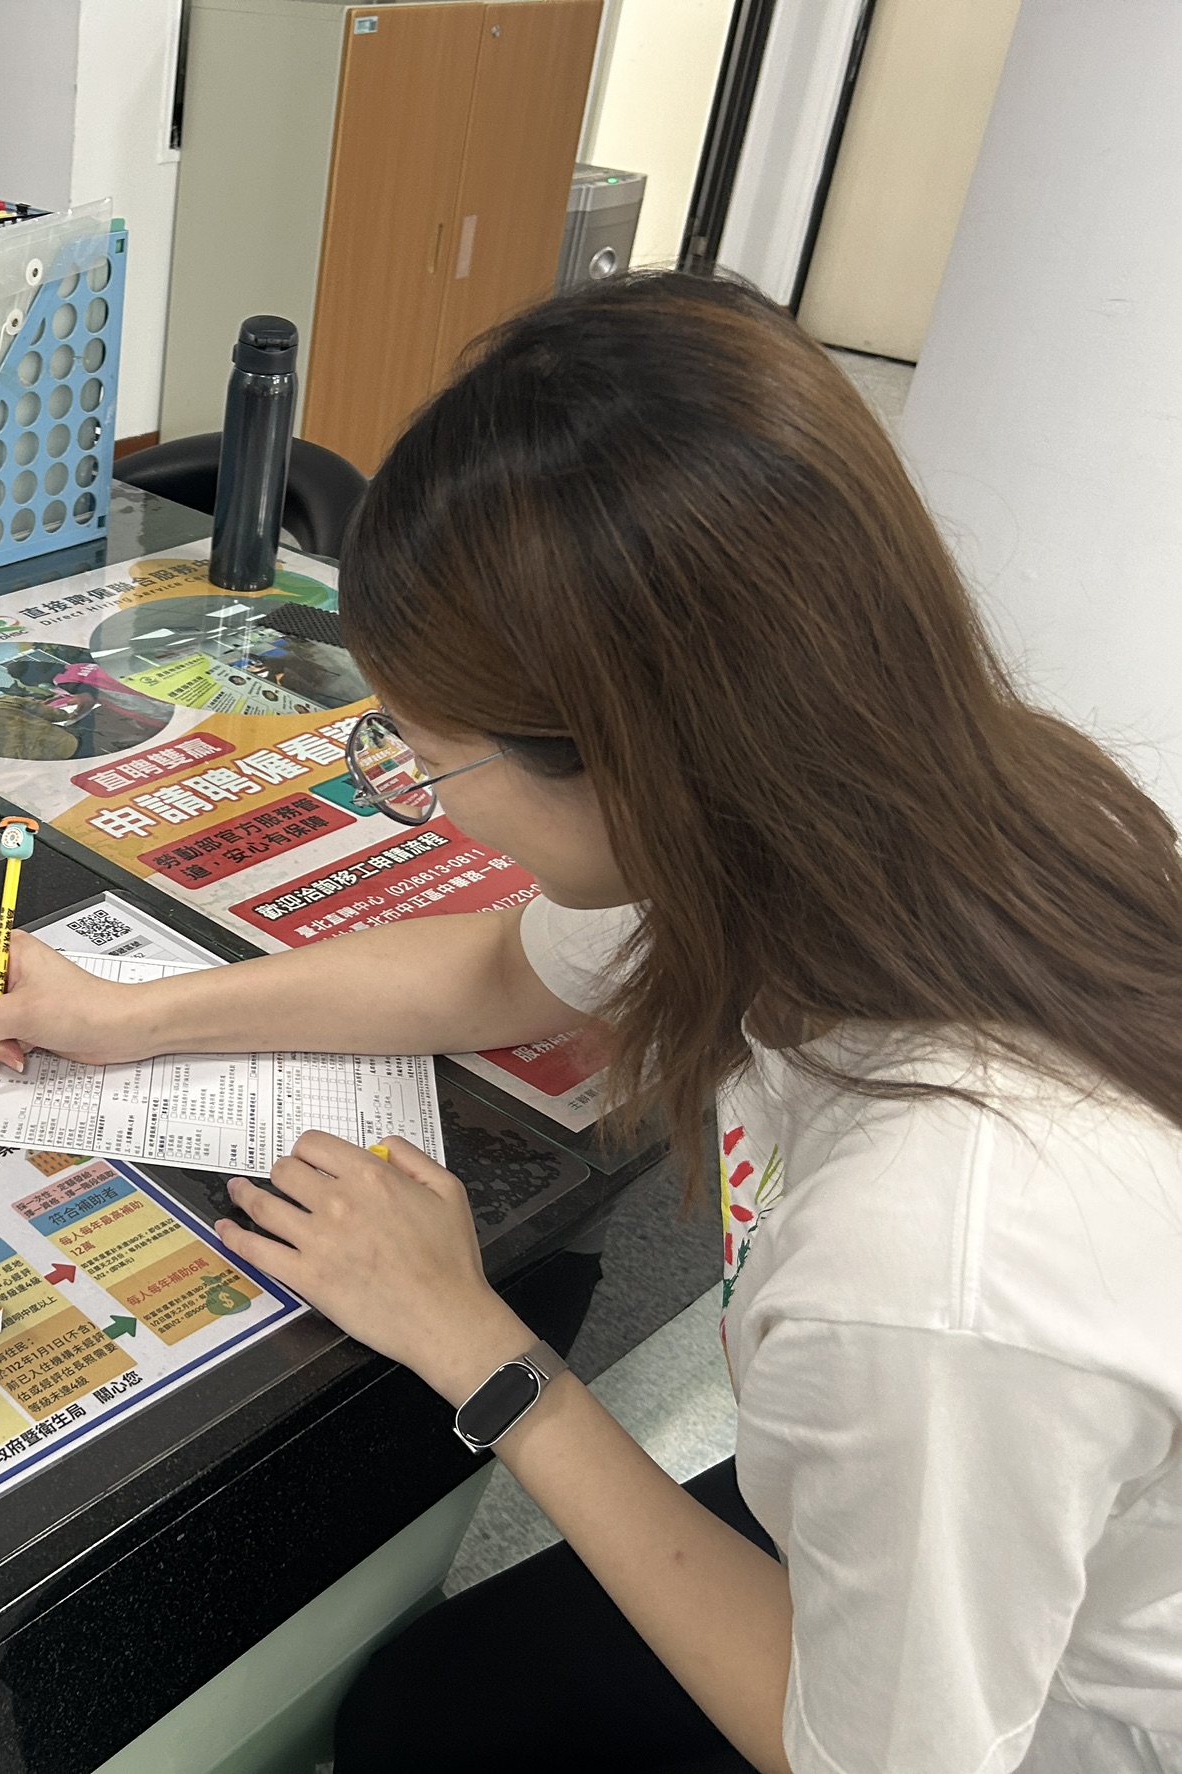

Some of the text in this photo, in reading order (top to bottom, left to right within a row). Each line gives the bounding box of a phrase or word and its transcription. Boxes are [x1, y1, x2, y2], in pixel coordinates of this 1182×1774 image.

[39, 609, 84, 628] Direct
[86, 596, 133, 614] Hiring
[134, 581, 183, 600] Service
[87, 737, 223, 792] 直聘雙贏
[152, 797, 322, 871] 勞動部官方服務管
[255, 831, 450, 921] 歡迎洽詢移工申請流程
[293, 848, 486, 940] 臺北直聘中心 (02)6613-0811
[48, 1186, 118, 1226] 符合補助者
[59, 1199, 145, 1247] 每人每年最高補助
[69, 1240, 96, 1258] 12萬
[126, 1257, 210, 1308] 每人每年補助6萬
[5, 1330, 105, 1392] 前已入住機構未經評
[17, 1341, 118, 1403] 估或經評估長照需要
[27, 1375, 90, 1414] 等級未達4級
[92, 1370, 144, 1405] 關心您
